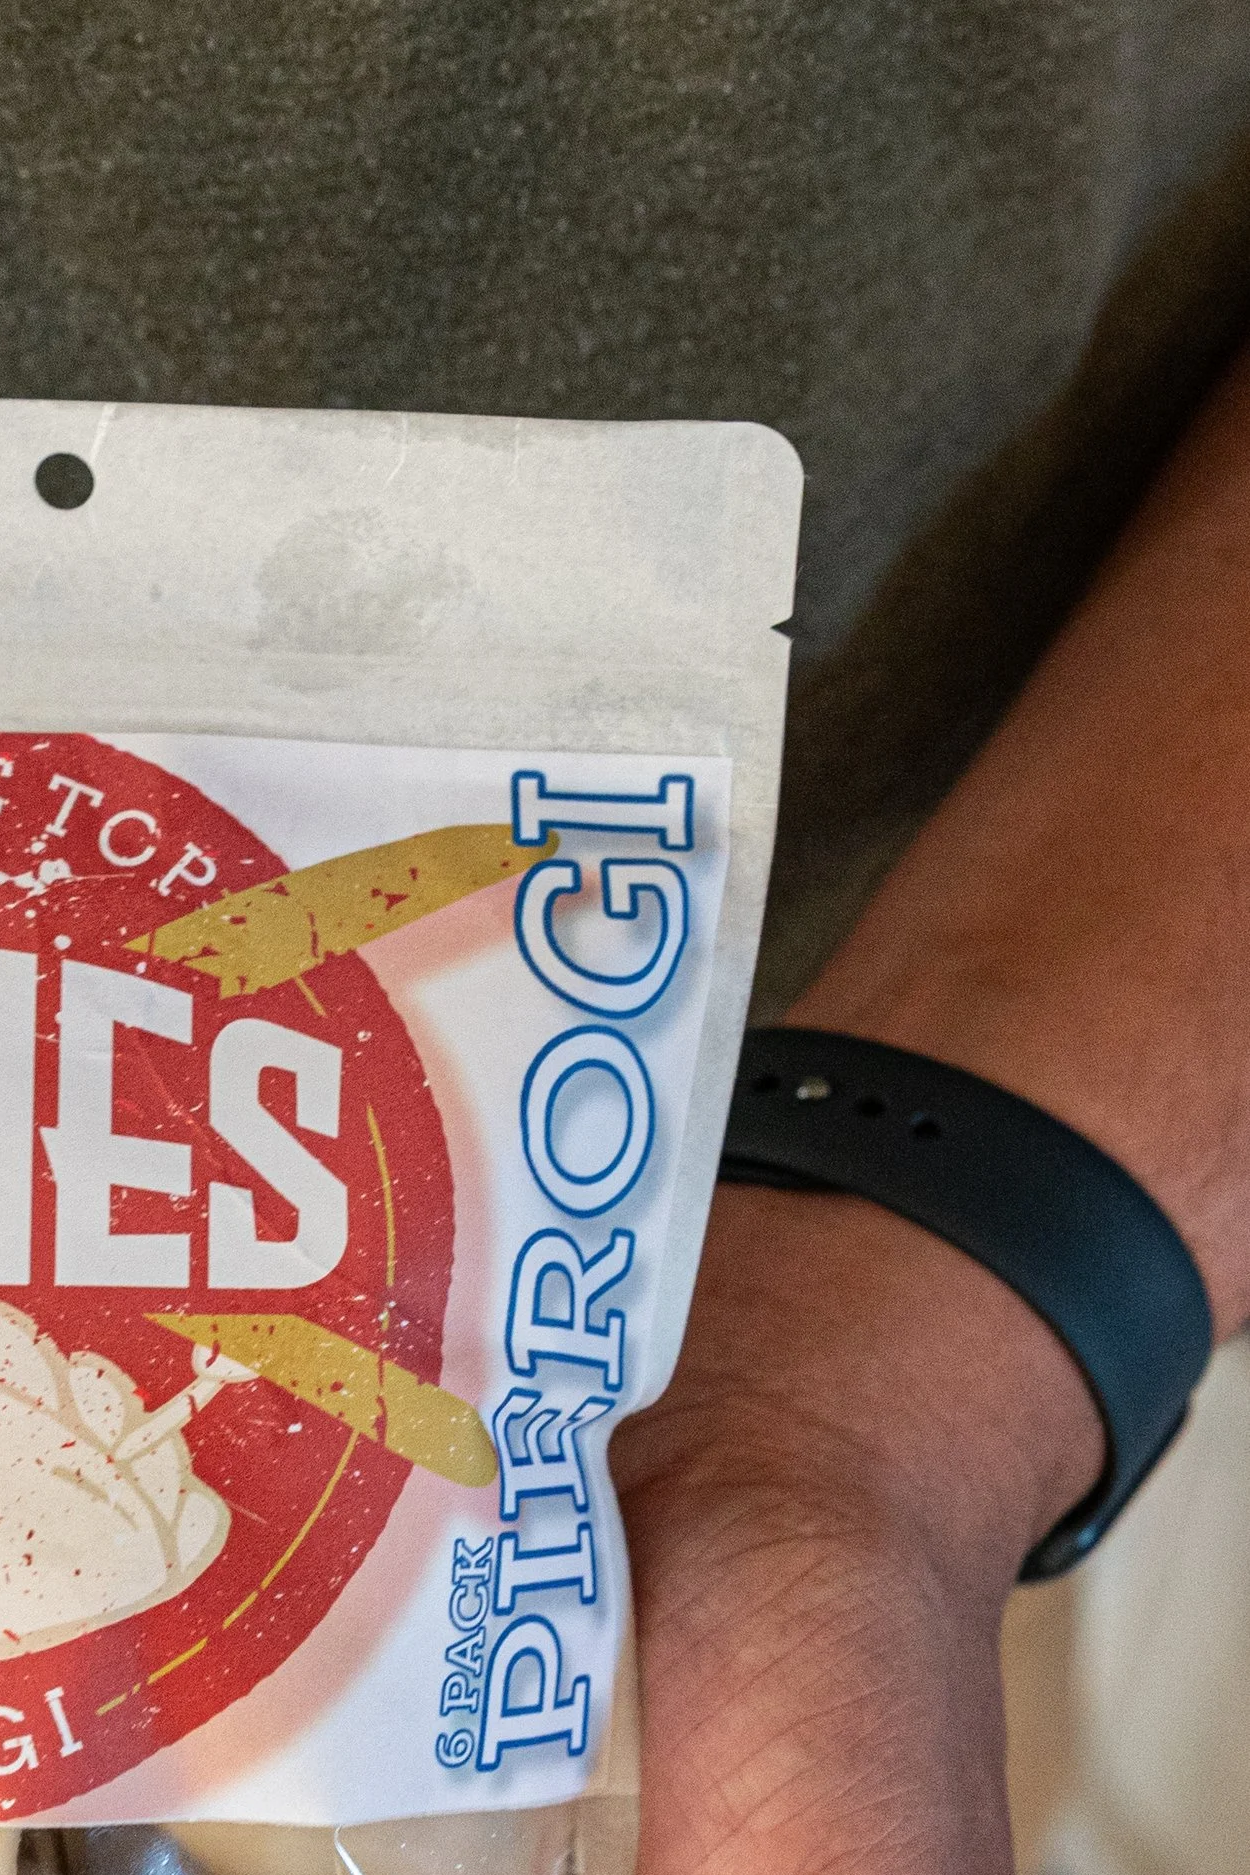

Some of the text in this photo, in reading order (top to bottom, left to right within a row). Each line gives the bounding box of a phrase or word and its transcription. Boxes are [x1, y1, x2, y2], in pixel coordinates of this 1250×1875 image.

[44, 774, 219, 898] TOP
[476, 769, 695, 1772] PIEROGI
[435, 1536, 494, 1768] 6 PACK
